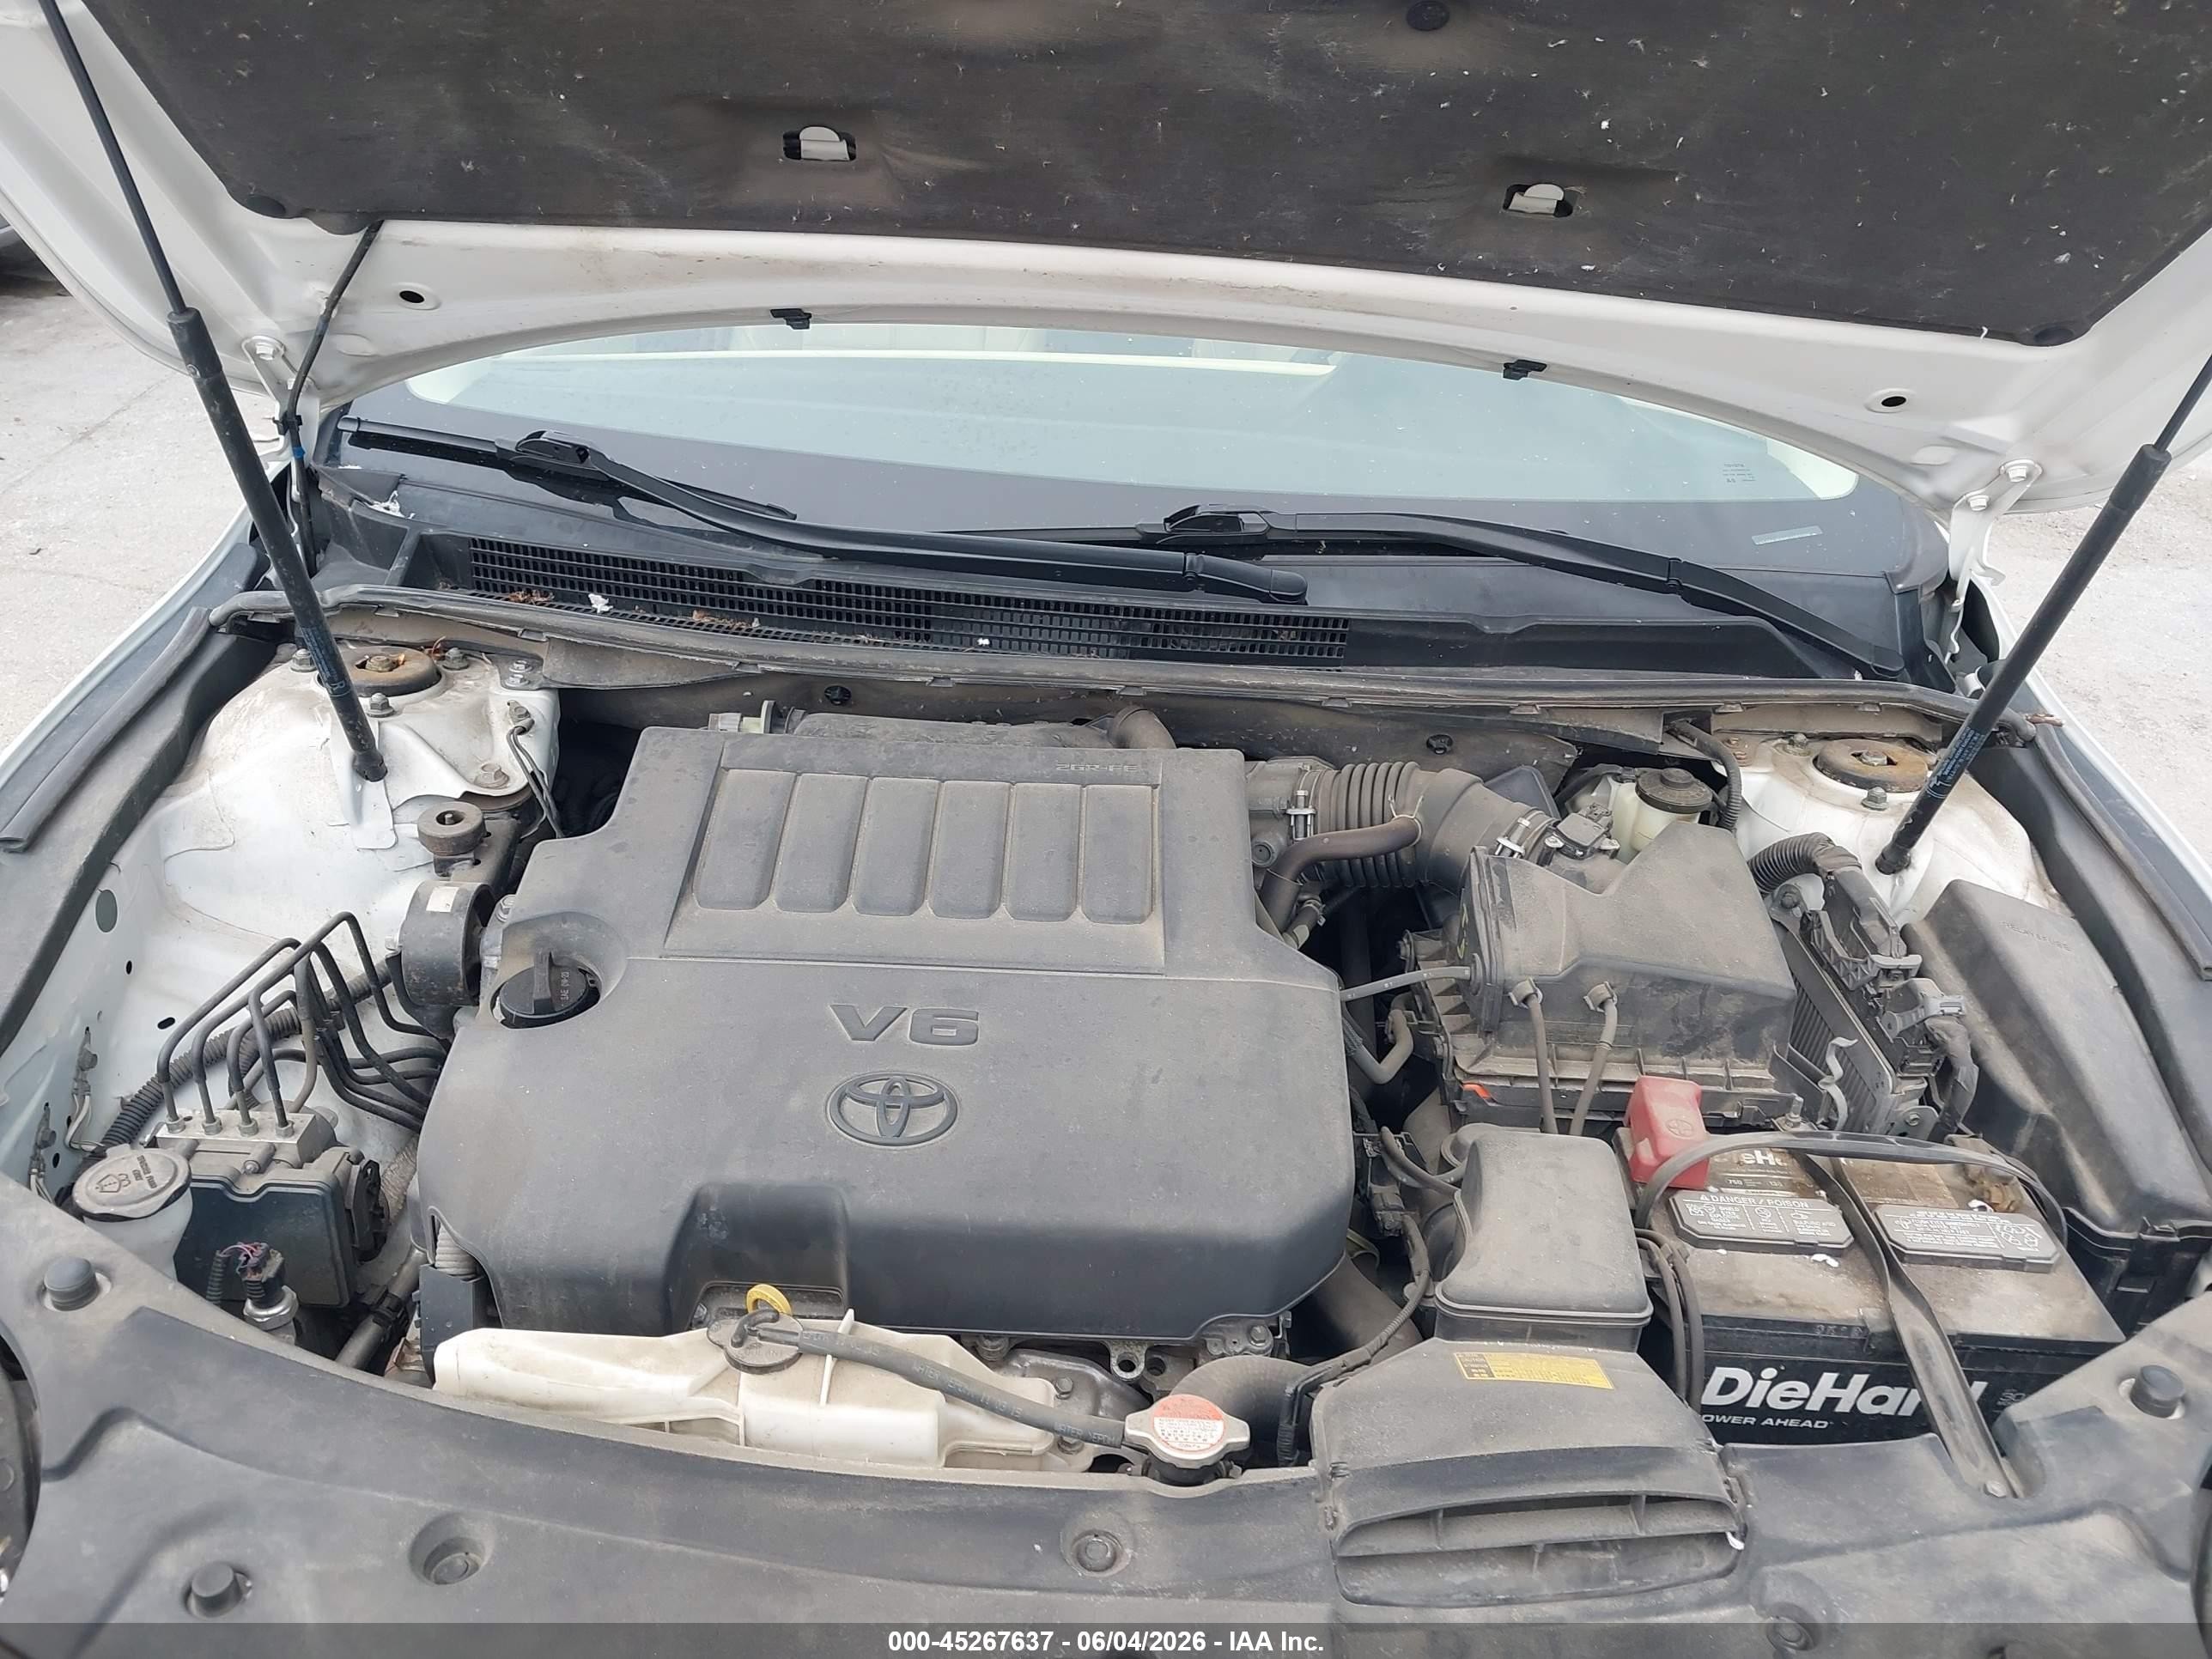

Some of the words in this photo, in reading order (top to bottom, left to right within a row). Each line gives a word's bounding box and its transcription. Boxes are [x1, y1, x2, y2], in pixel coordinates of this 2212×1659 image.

[829, 1003, 981, 1048] V6
[1712, 1194, 1756, 1206] DANGER
[1765, 1199, 1809, 1208] POISON
[1701, 1413, 1755, 1426] OWER
[1760, 1417, 1829, 1430] AHEAD
